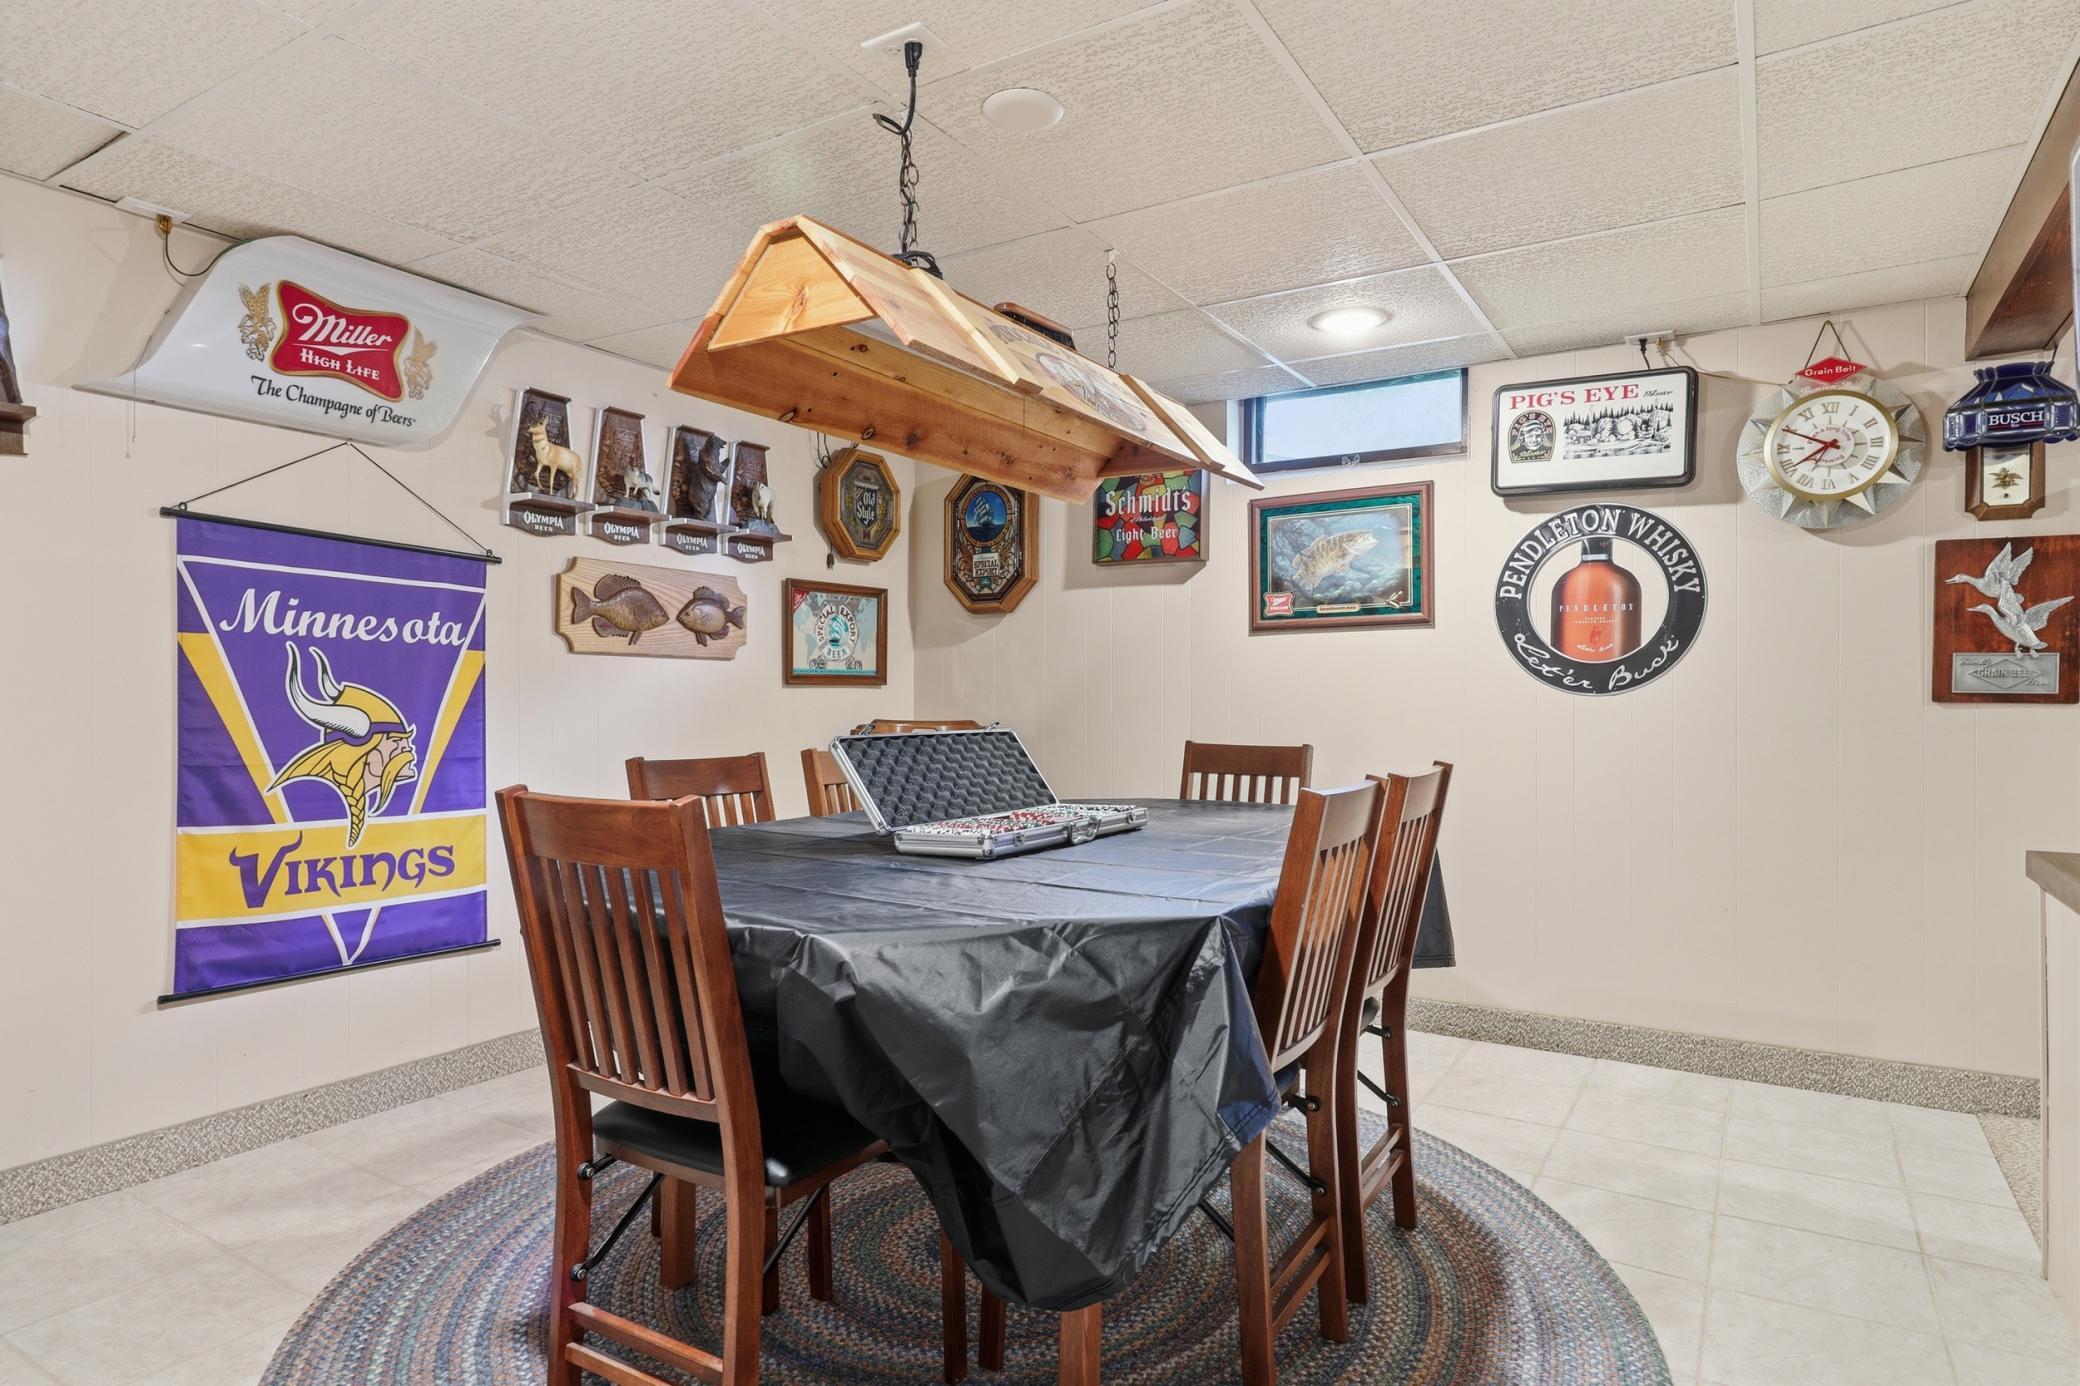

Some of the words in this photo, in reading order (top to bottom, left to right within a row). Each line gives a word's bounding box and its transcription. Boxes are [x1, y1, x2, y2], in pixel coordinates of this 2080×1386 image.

[292, 303, 393, 347] Miller
[300, 347, 341, 370] HIGH
[345, 360, 380, 381] LIFE
[1804, 367, 1834, 377] Grain
[1834, 364, 1856, 374] Belt
[250, 375, 282, 398] The
[285, 384, 363, 419] Champagne
[365, 403, 379, 424] of
[377, 405, 414, 427] Beers
[1509, 390, 1576, 410] PIG'S
[1584, 383, 1639, 403] EYE
[1796, 407, 1815, 421] XI
[1821, 401, 1840, 414] XII
[1988, 410, 2045, 426] BUSCH
[1776, 443, 1791, 456] IX
[1870, 436, 1884, 448] III
[1821, 478, 1836, 490] VI
[1849, 472, 1860, 484] V
[863, 491, 876, 507] Old
[1105, 486, 1191, 517] Schmidt's
[523, 510, 565, 530] OLYMPIA
[856, 500, 875, 525] Style
[534, 524, 553, 532] BEER
[603, 521, 640, 539] OLYMPIA
[1116, 527, 1145, 544] Light
[1151, 526, 1178, 540] Beer
[676, 532, 709, 549] OLYMPIA
[737, 542, 765, 557] OLYMPIA
[1499, 508, 1622, 600] PENDLETON
[1627, 512, 1701, 593] WHISKY
[219, 588, 467, 647] Minnesota
[817, 605, 835, 642] SPECIAL
[839, 606, 857, 643] EXPORT
[826, 648, 848, 659] BEER
[228, 830, 456, 909] VIKINGS
